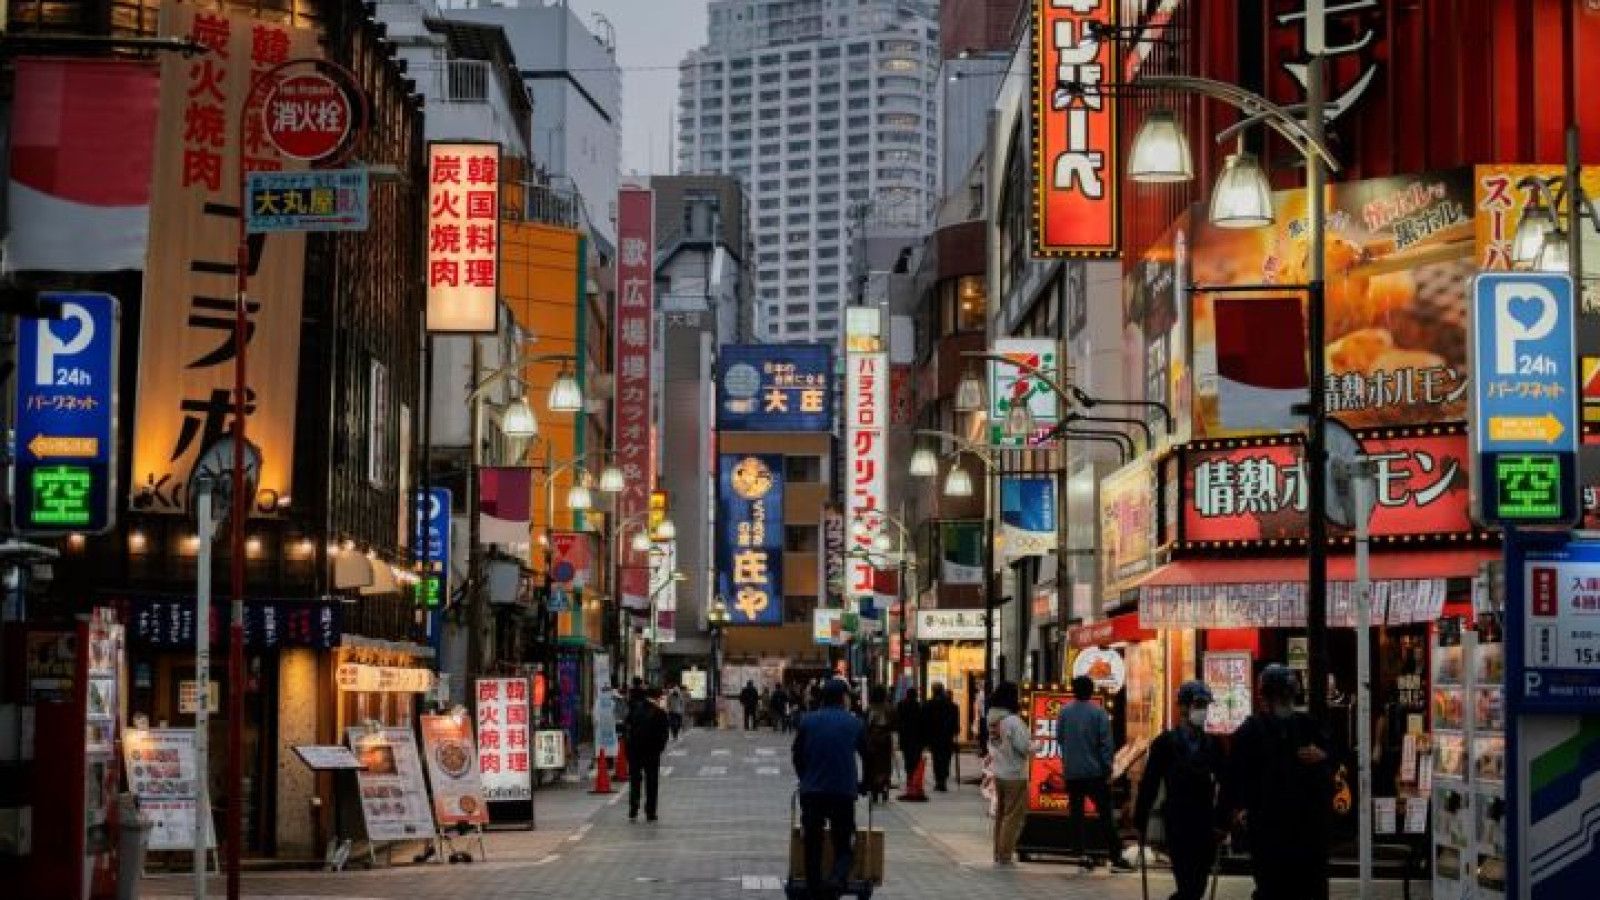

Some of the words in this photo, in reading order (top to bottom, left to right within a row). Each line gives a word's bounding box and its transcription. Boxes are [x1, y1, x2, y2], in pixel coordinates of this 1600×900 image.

[182, 14, 230, 191] 炭火焼肉
[273, 101, 343, 132] 消火栓
[430, 156, 460, 287] 炭火焼肉
[465, 157, 496, 287] 韓国料理
[36, 303, 95, 386] P
[1495, 282, 1558, 374] P
[1519, 355, 1557, 375] 24h
[56, 368, 91, 386] 24h
[764, 389, 824, 412] 大庄
[31, 466, 90, 524] 空
[1194, 451, 1457, 516] 情熱ホモン
[1498, 456, 1561, 516] 空
[480, 681, 500, 773] 炭火焼肉
[506, 681, 528, 771] 韓国料理
